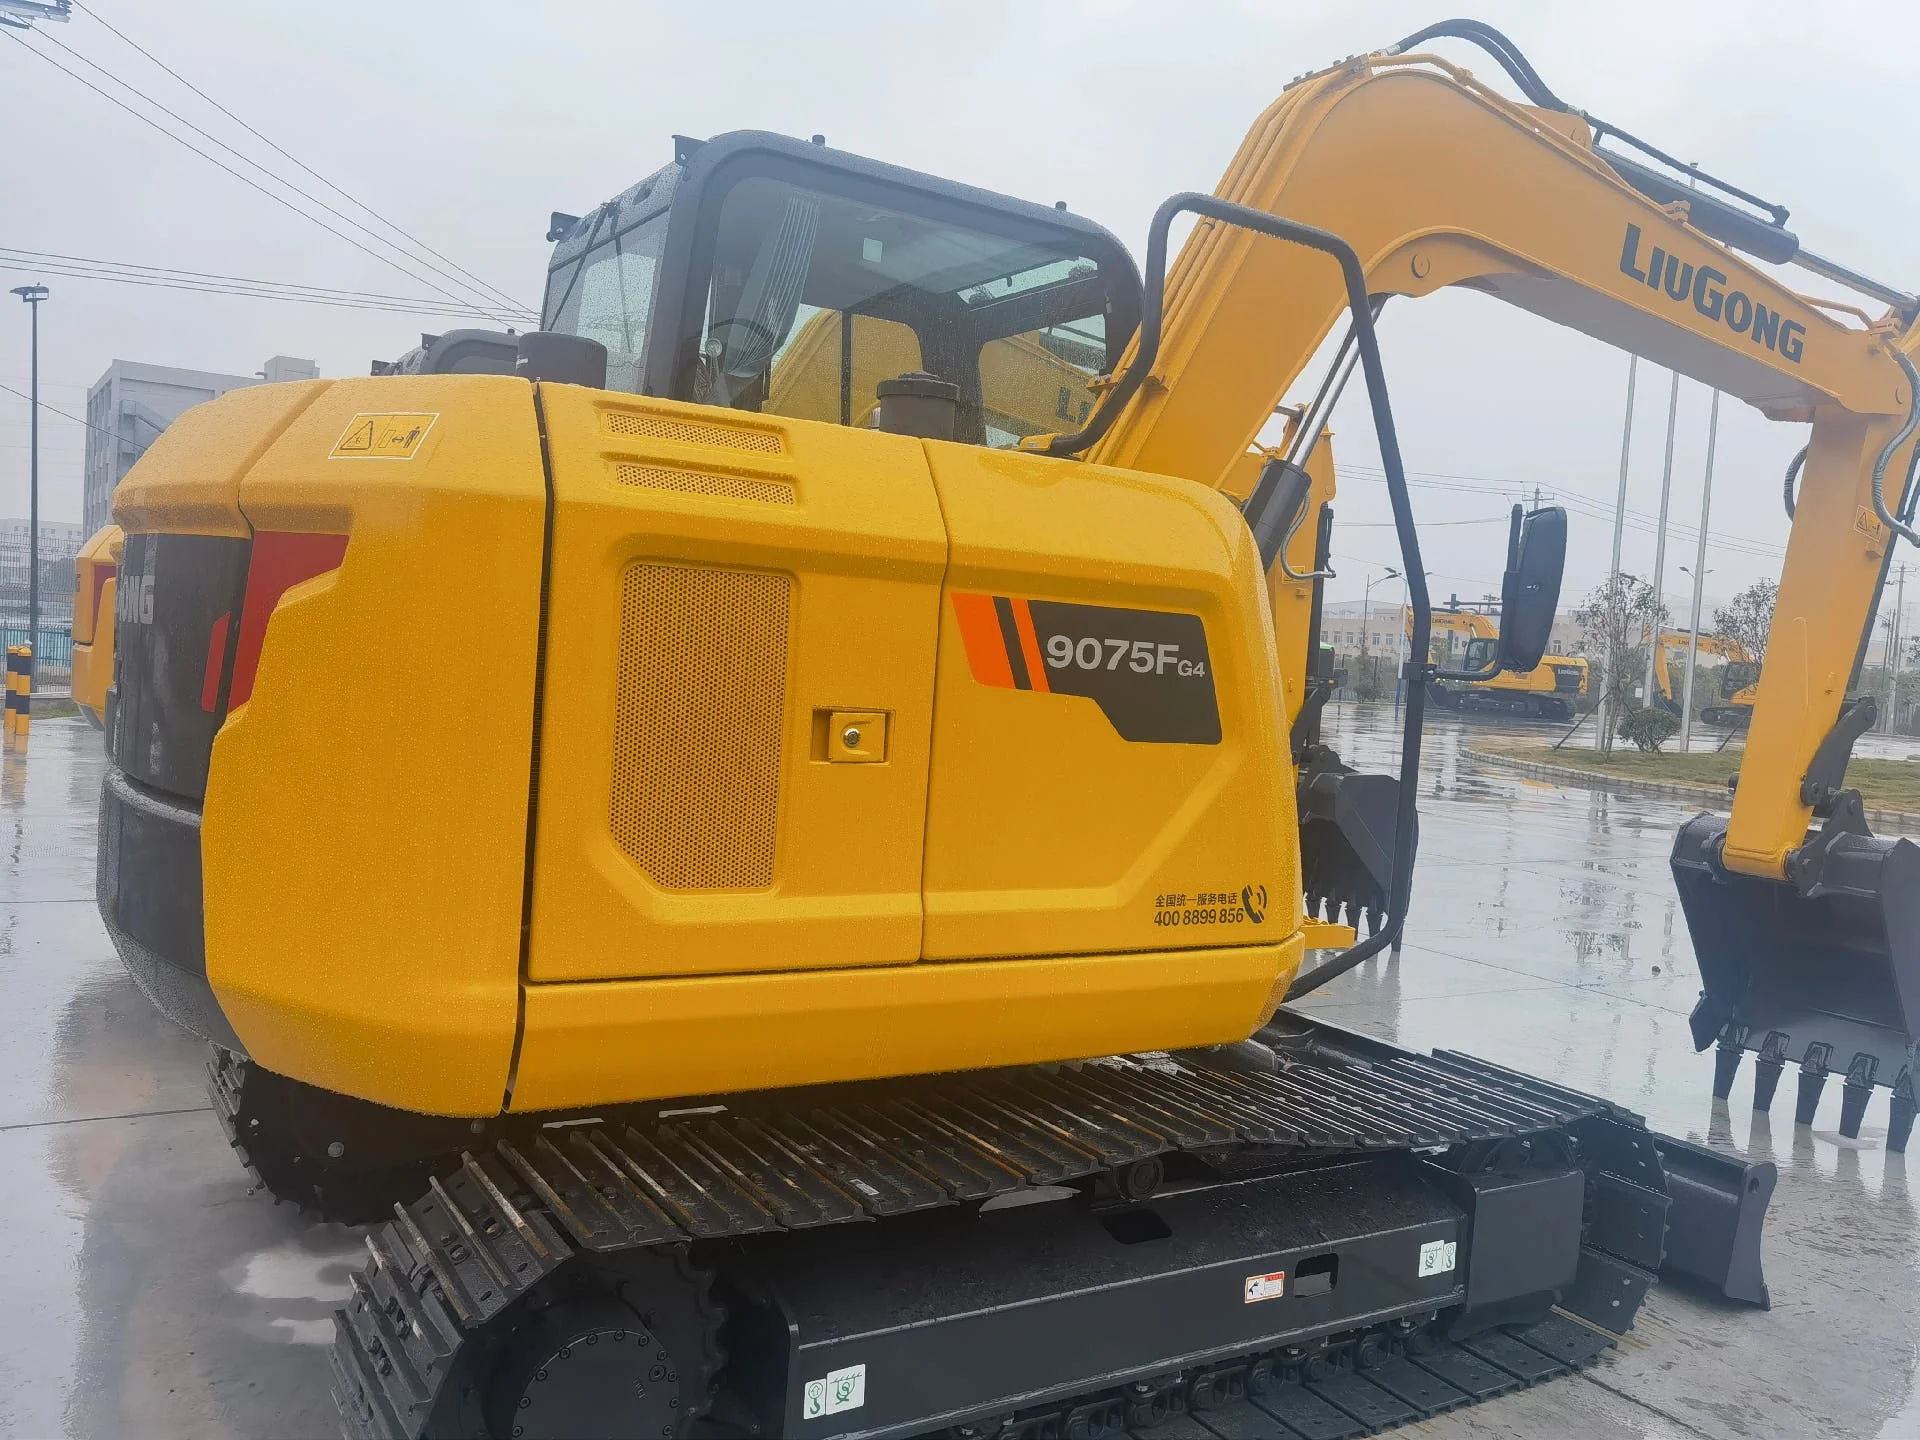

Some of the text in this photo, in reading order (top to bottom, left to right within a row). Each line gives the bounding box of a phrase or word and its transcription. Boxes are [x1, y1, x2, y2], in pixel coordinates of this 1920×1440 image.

[1155, 893, 1238, 908] 全国统一服务电话
[1154, 907, 1244, 927] 400 8899 856
